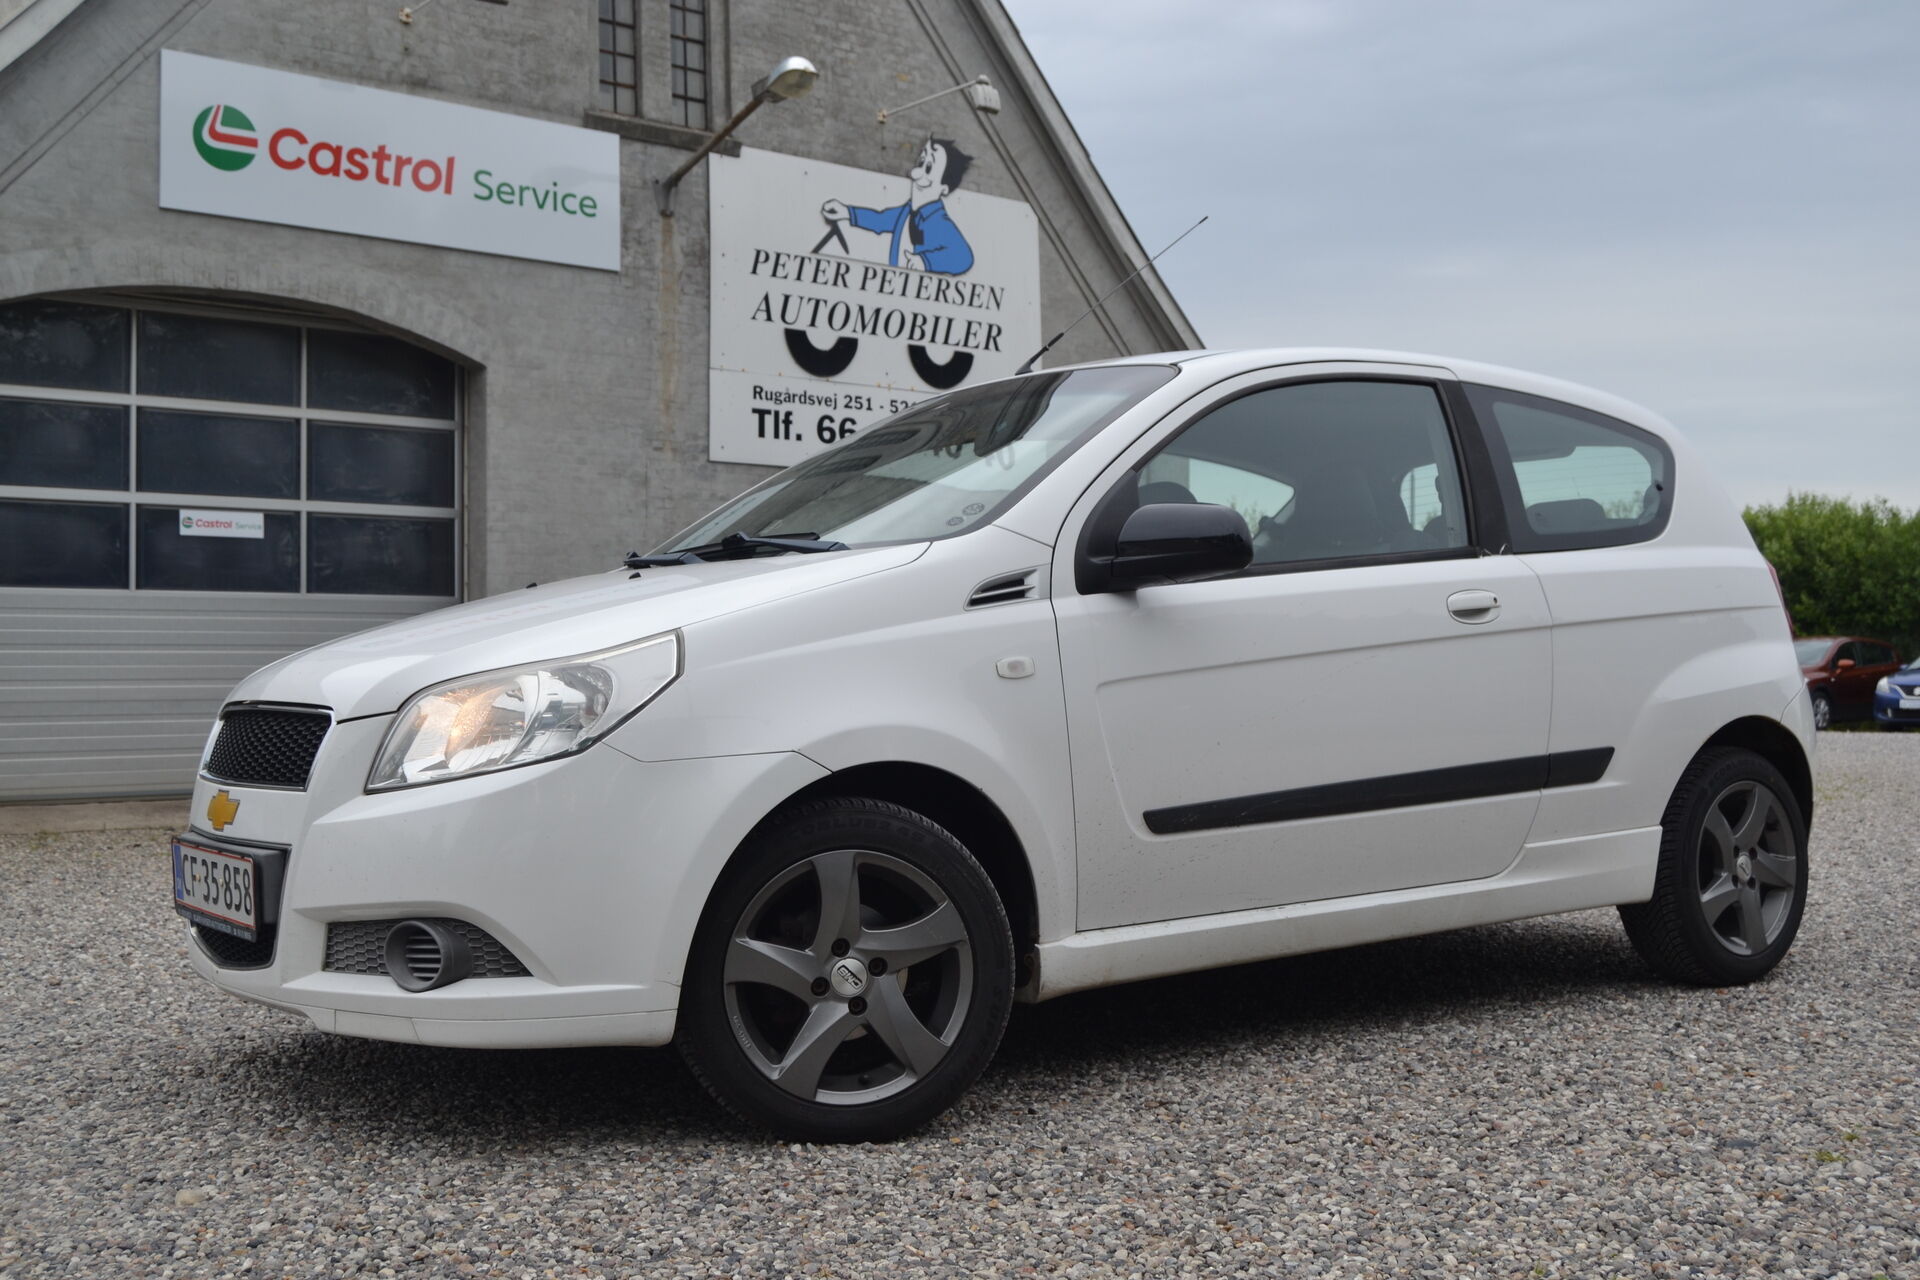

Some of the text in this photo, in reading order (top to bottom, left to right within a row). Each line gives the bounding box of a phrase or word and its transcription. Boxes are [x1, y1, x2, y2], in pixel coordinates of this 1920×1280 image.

[268, 127, 598, 218] Castrol Service
[750, 248, 1005, 312] PETER PETERSEN
[750, 291, 1003, 352] AUTOMOBILER
[753, 385, 838, 410] Rugårdsvej
[843, 394, 873, 411] 251
[752, 408, 857, 444] Tlf. 66
[195, 518, 233, 529] Castrol
